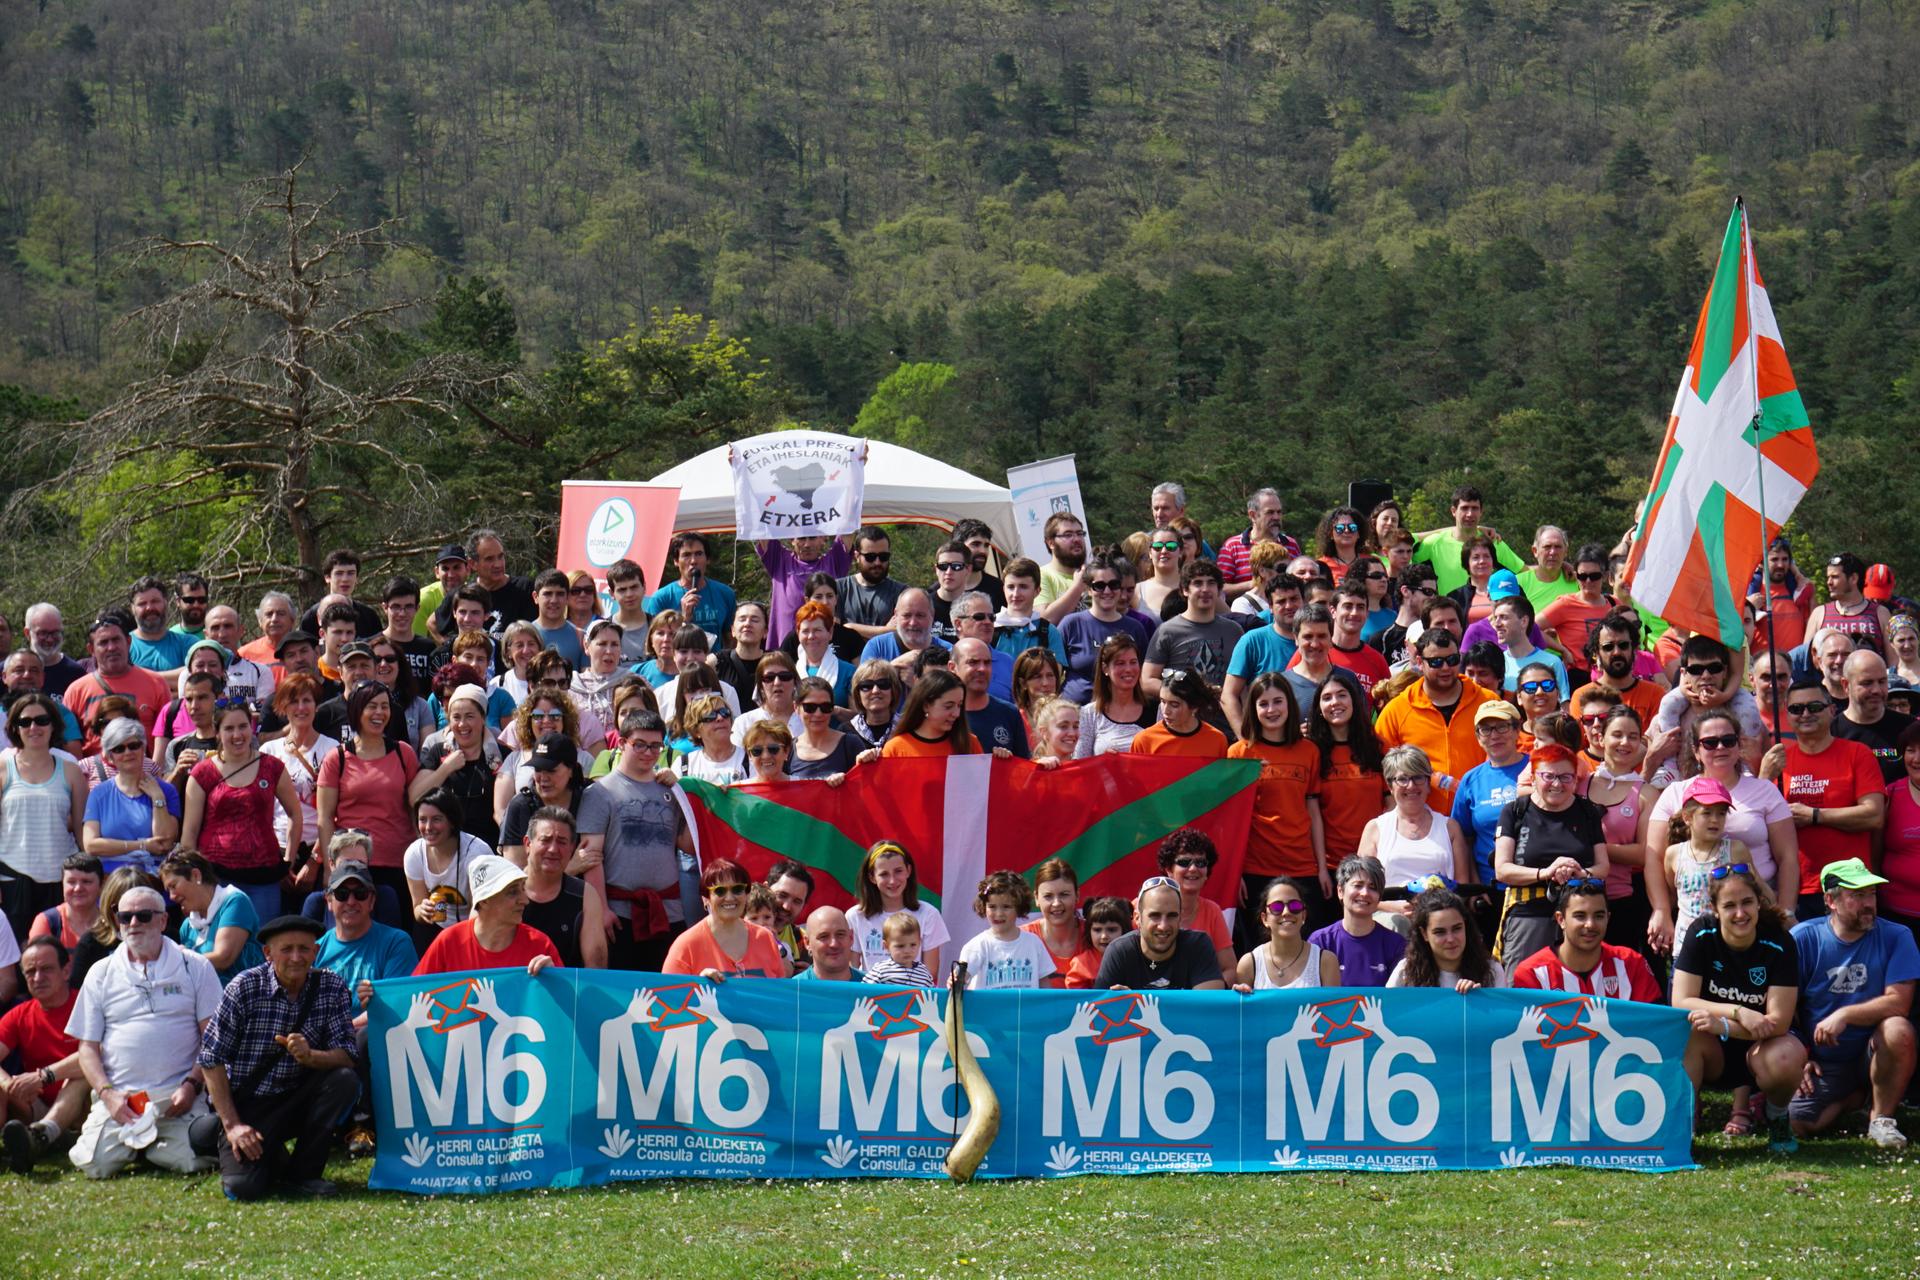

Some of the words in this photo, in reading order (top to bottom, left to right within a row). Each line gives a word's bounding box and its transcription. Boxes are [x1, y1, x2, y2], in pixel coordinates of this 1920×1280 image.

[743, 440, 801, 460] EUSKAL
[806, 439, 855, 452] PRESO
[747, 457, 771, 475] ETA
[773, 450, 853, 469] IHESLARIAK
[759, 507, 841, 527] ETXERA
[1790, 780, 1829, 788] DAITEZEN
[1791, 774, 1813, 782] MUGI
[1790, 787, 1825, 795] HARRIAK
[1709, 980, 1767, 1006] betway
[386, 1016, 547, 1129] M6
[596, 1019, 770, 1128] M6
[1042, 1033, 1215, 1140] M6
[1265, 1036, 1440, 1143] M6
[1490, 1037, 1666, 1143] M6
[437, 1138, 472, 1153] HERRI
[477, 1134, 543, 1151] GALDEKETA
[637, 1134, 677, 1148] HERRI
[684, 1136, 766, 1152] GALDEKETA
[860, 1145, 900, 1157] HERRI
[436, 1152, 484, 1167] Consulta
[488, 1148, 544, 1165] ciudadana
[636, 1147, 693, 1162] Consulta
[699, 1150, 766, 1165] ciudadana
[860, 1158, 915, 1171] Consulta
[1083, 1151, 1123, 1162] HERRI
[1131, 1151, 1212, 1163] GALDEKETA
[1355, 1155, 1437, 1168] GALDEKETA
[1581, 1156, 1665, 1167] GALDEKETA
[410, 1176, 470, 1188] MAIATZAK
[474, 1176, 482, 1187] 6
[485, 1175, 498, 1187] DE
[500, 1170, 533, 1183] MAYO
[609, 1169, 673, 1177] MAIATZAK
